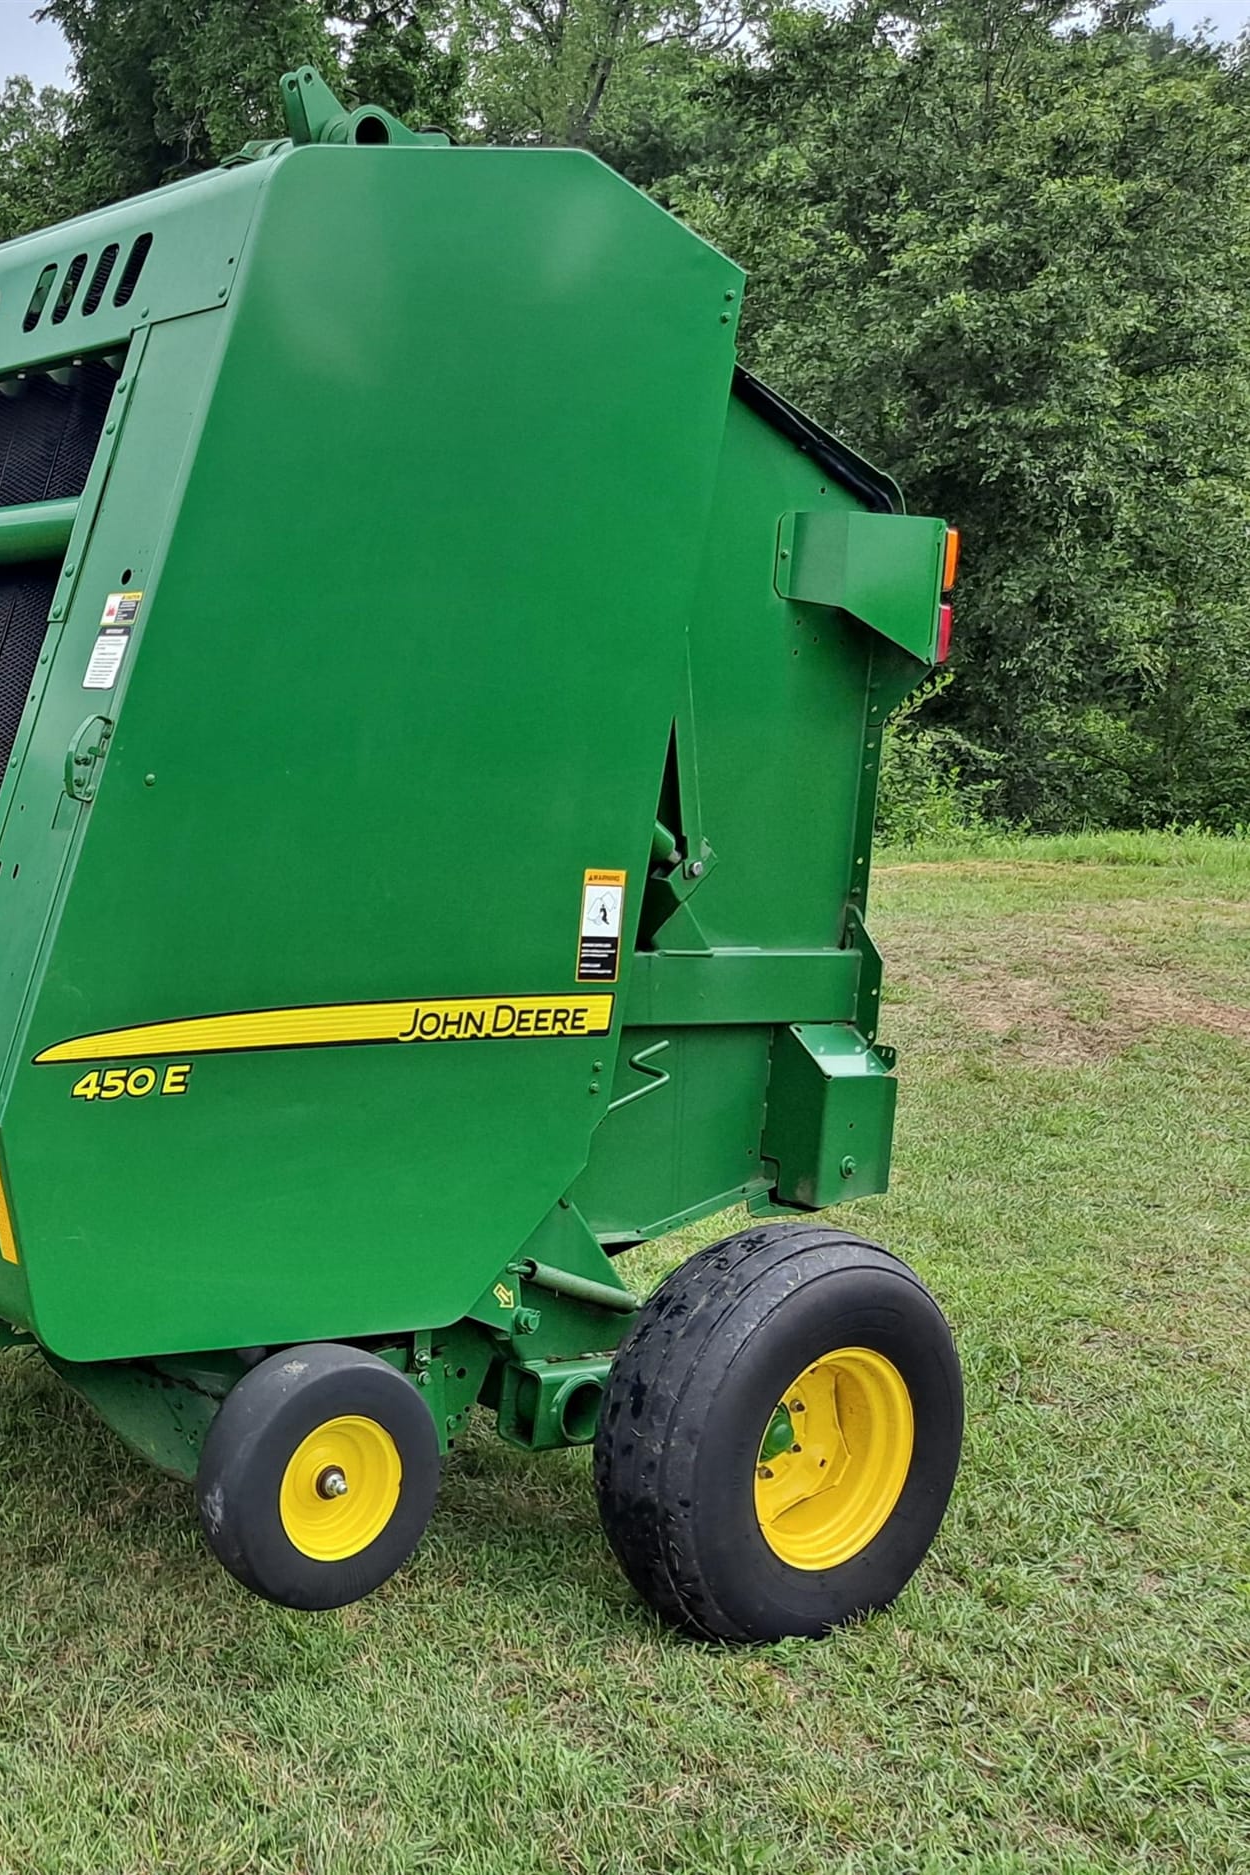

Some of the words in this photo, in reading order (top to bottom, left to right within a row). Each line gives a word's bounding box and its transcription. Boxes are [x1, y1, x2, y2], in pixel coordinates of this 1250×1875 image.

[399, 1008, 486, 1038] JOHN
[491, 1004, 589, 1033] DEERE
[72, 1066, 156, 1100] 450
[161, 1064, 192, 1094] E
